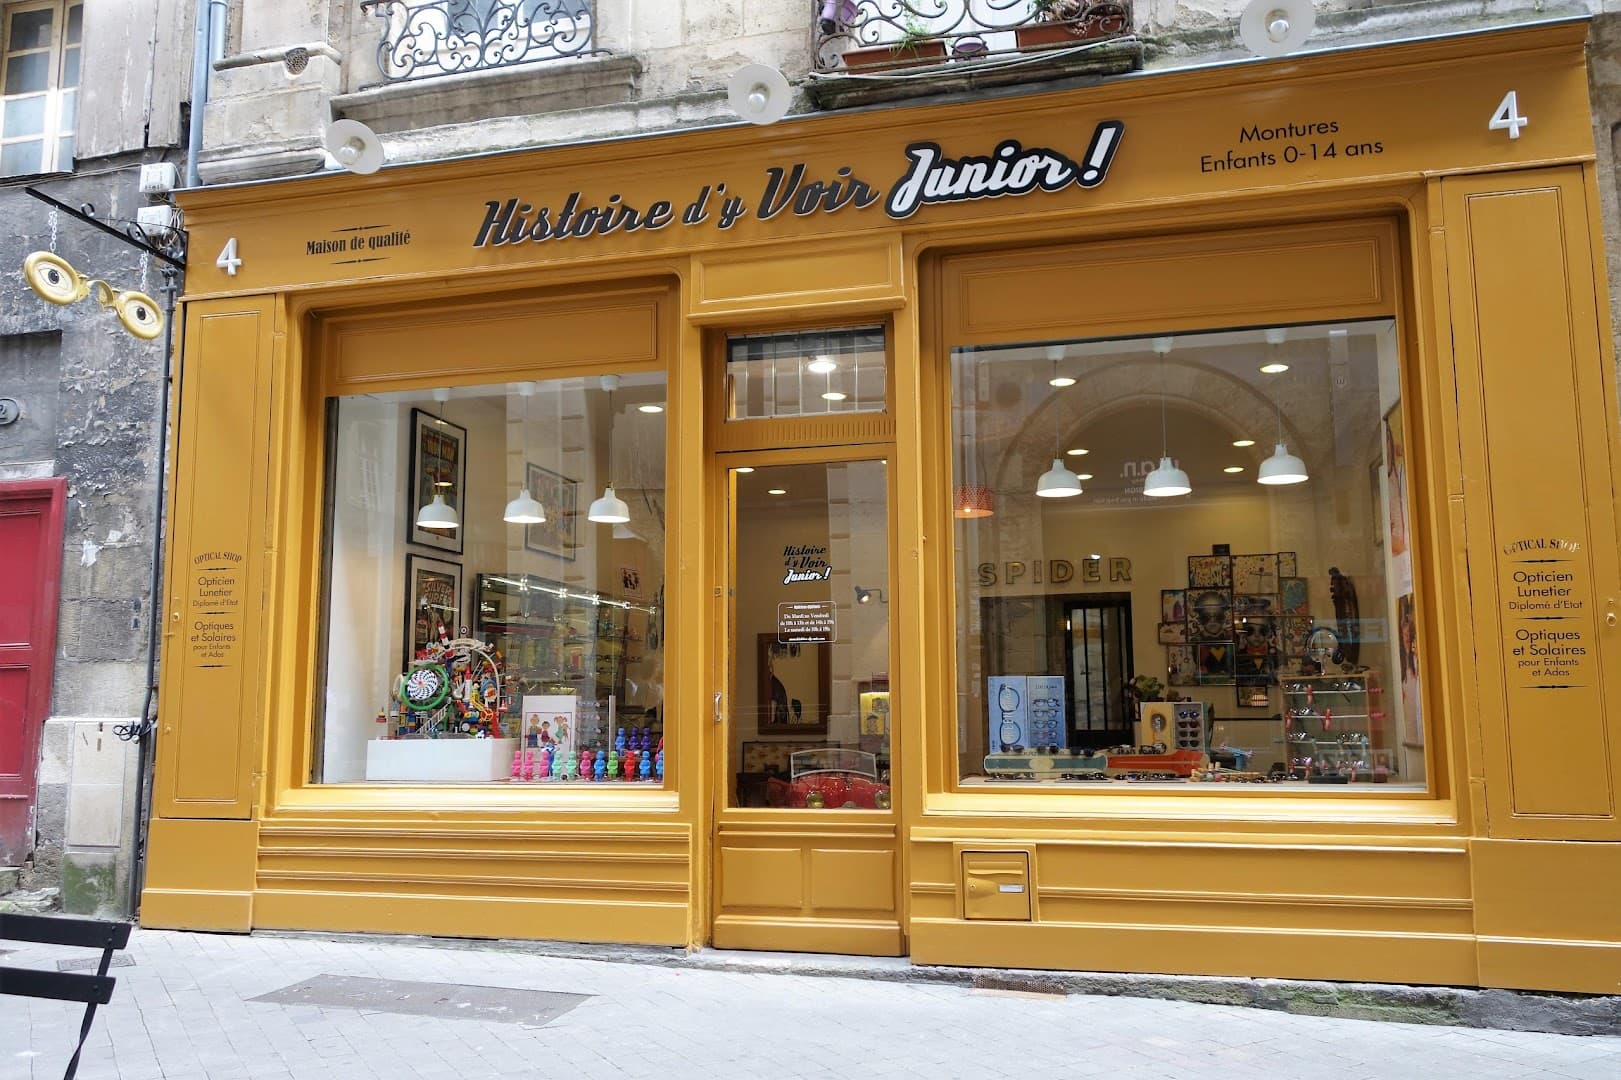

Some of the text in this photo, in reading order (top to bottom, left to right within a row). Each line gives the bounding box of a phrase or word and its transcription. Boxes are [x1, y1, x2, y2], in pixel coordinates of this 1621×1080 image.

[1488, 89, 1528, 140] 4
[1239, 119, 1339, 143] Montures
[1200, 140, 1384, 173] Enfants 0-14 ans
[473, 191, 675, 248] Histoire
[681, 183, 747, 231] d'y
[755, 163, 881, 221] Voir
[306, 229, 411, 255] Maison de qualité
[215, 237, 242, 276] 4
[784, 545, 827, 556] Histoire
[194, 551, 242, 565] OPTICAL SHOP
[800, 557, 827, 568] Voir
[977, 557, 1132, 587] SPIDER
[1513, 571, 1573, 586] Opticien
[198, 576, 235, 588] Opticien
[199, 588, 232, 597] Lunetier
[1517, 585, 1572, 597] Lunetier
[194, 621, 234, 633] Optiques
[190, 632, 236, 642] et Solaires
[1515, 628, 1581, 643] Optiques
[192, 644, 208, 652] pour
[1512, 643, 1586, 656] et Solaires
[1518, 656, 1579, 669] pour Enfants
[1532, 668, 1570, 677] et Ados
